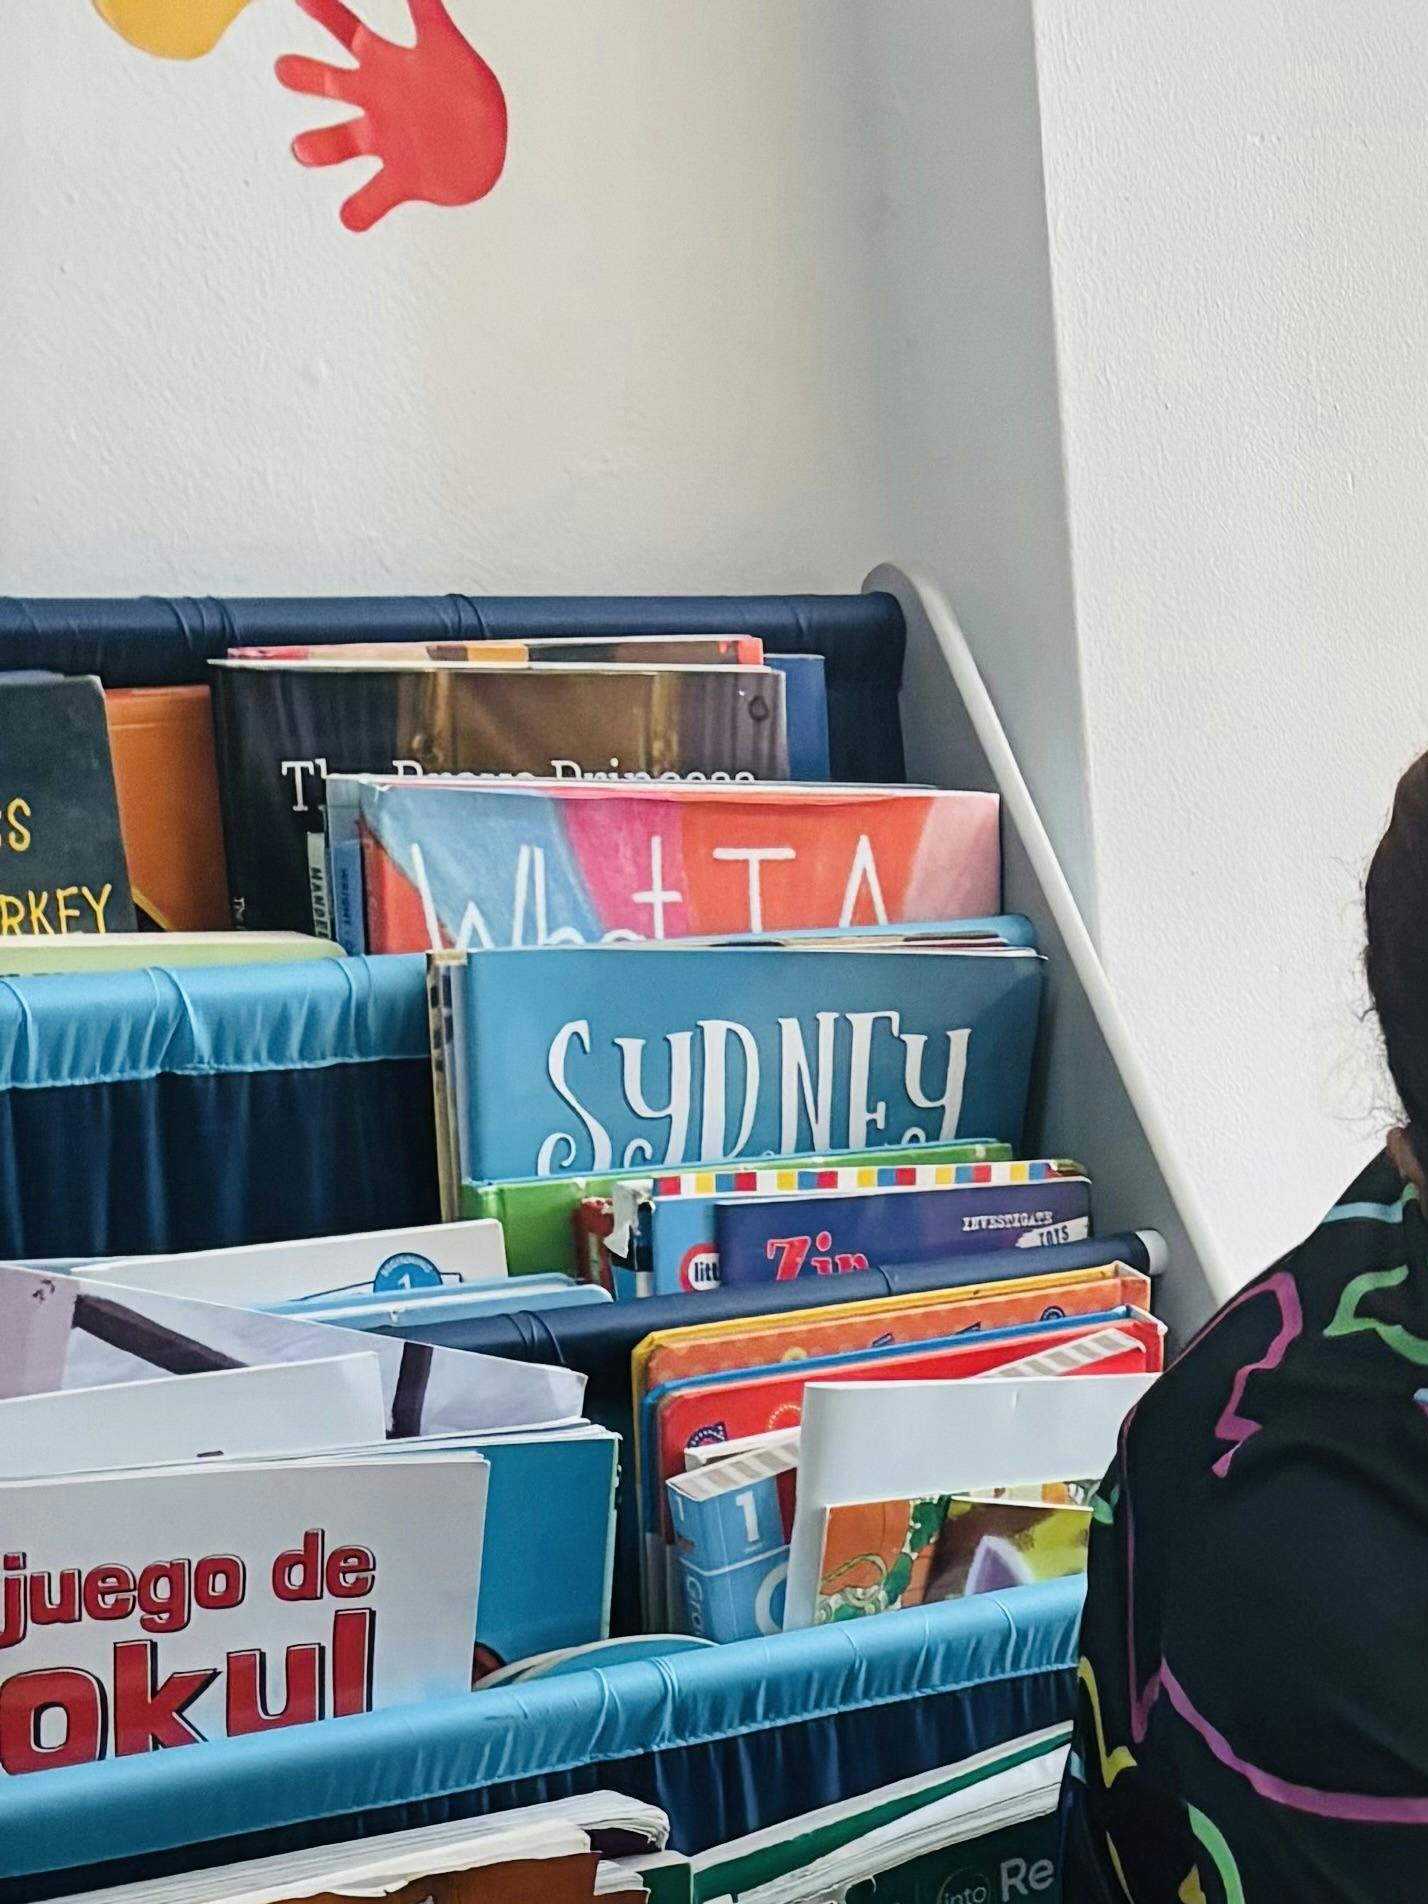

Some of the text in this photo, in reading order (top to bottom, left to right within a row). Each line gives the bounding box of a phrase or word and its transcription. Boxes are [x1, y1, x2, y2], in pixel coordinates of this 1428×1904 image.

[735, 1490, 760, 1542] 1
[0, 1527, 377, 1649] juego de
[1000, 1857, 1055, 1903] Re
